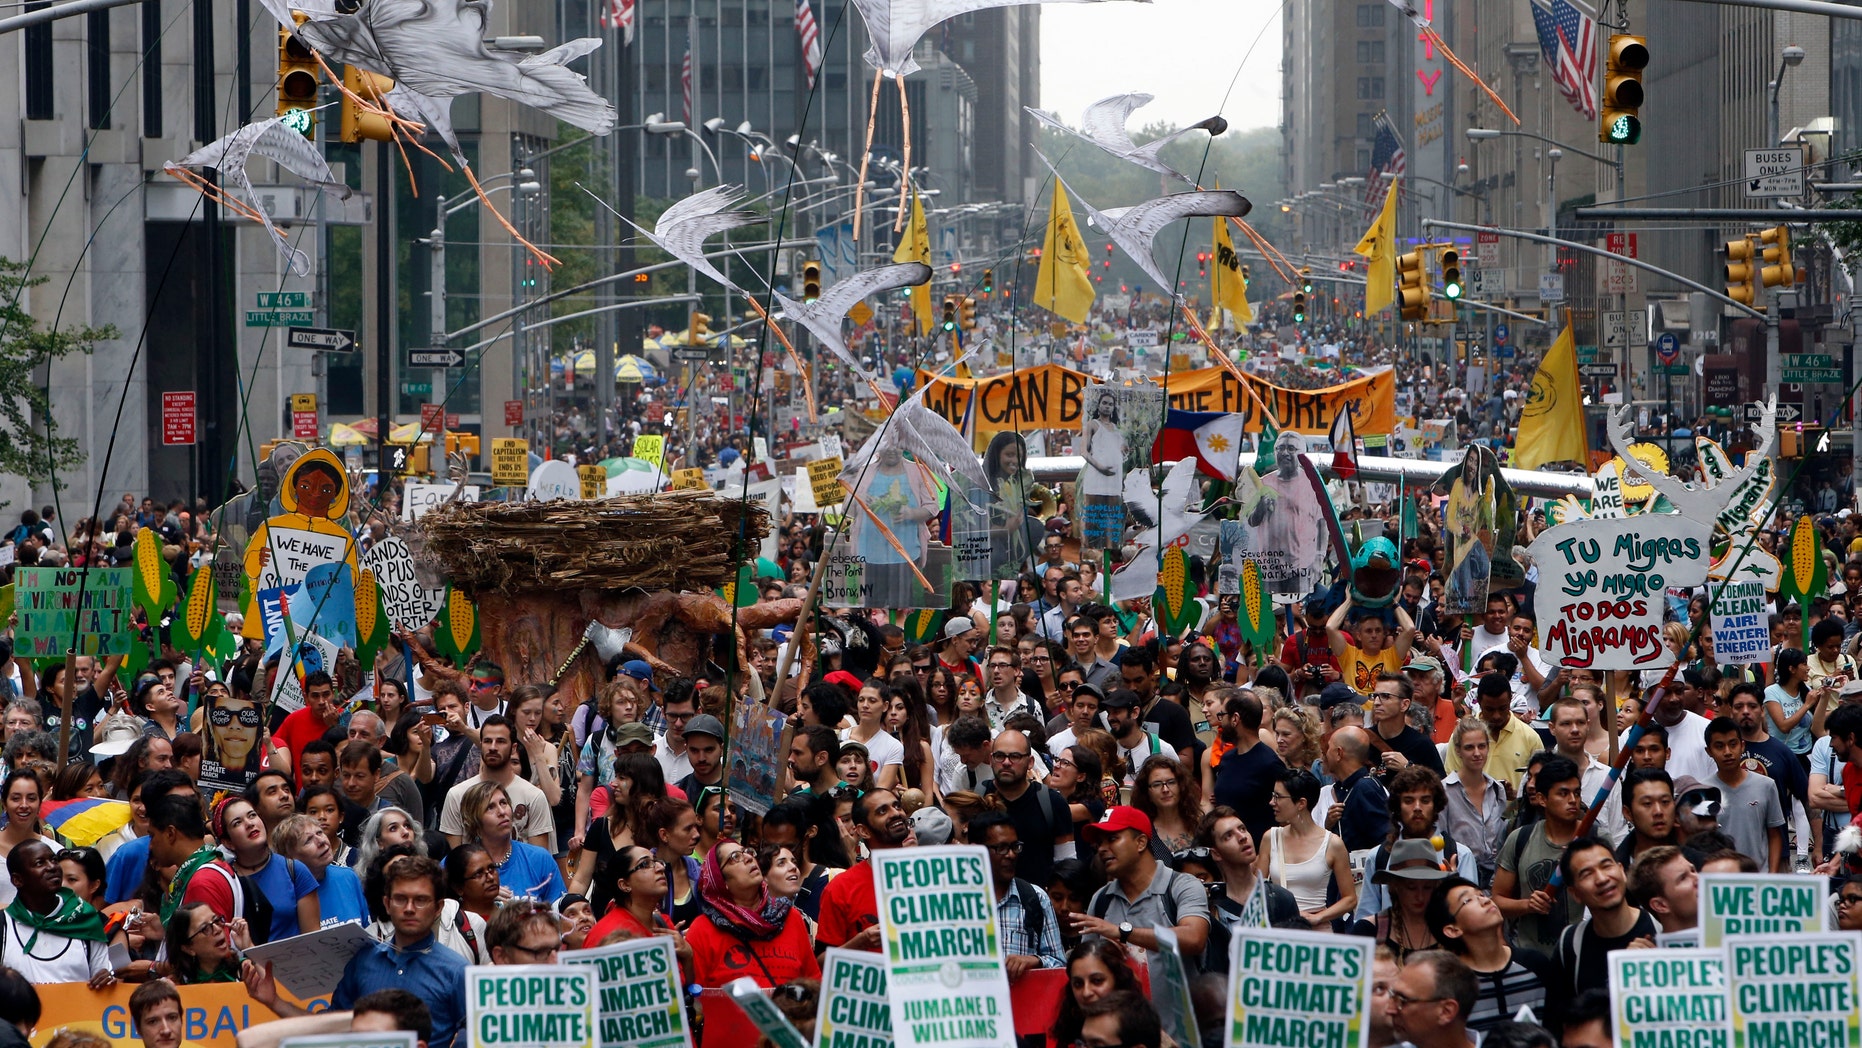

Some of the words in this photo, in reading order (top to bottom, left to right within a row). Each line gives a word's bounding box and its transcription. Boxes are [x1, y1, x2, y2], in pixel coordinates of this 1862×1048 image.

[1756, 153, 1792, 163] BUSES
[1760, 166, 1788, 175] ONLY
[1480, 234, 1496, 242] ZONE
[260, 294, 269, 306] W
[277, 294, 292, 306] 46
[246, 313, 275, 321] LITTLE
[280, 312, 312, 321] BRAZIL
[298, 333, 316, 343] ONE
[325, 336, 345, 345] WAY
[1613, 326, 1636, 334] ONY
[1693, 331, 1717, 340] 1212
[1791, 356, 1800, 365] W
[1805, 356, 1820, 365] 46
[1782, 370, 1808, 378] LITTLE
[1812, 370, 1840, 378] BRAZIL
[924, 376, 965, 425] WE
[981, 370, 1050, 424] CAN
[1221, 370, 1328, 430] FUTURE
[635, 438, 660, 454] SOLAR
[514, 463, 521, 471] US
[814, 463, 835, 472] HUMAN
[1699, 444, 1723, 480] Tod
[811, 472, 828, 481] NEEDS
[1595, 477, 1618, 491] WE
[410, 485, 473, 506] Earh
[1592, 494, 1622, 510] ARE
[1716, 458, 1770, 532] Migrantes
[277, 535, 301, 552] WE
[301, 542, 334, 560] HAVE
[364, 540, 408, 567] HANDS
[1240, 549, 1284, 558] Severiano
[1555, 537, 1600, 565] TU
[288, 558, 308, 572] THE
[826, 565, 842, 577] The
[844, 564, 863, 577] Point
[19, 570, 38, 587] I'M
[55, 571, 89, 586] NOT
[97, 571, 120, 586] AN
[15, 585, 132, 610] ENVIRONMNTALIST
[382, 583, 410, 605] NDS
[1727, 583, 1764, 598] DEMAND
[386, 600, 436, 616] OTHER
[1560, 600, 1647, 623] TODOS
[1712, 598, 1766, 616] CLEAN:
[24, 612, 46, 632] I'M
[54, 611, 75, 631] AN
[82, 610, 131, 634] EARTH
[263, 599, 284, 637] ON'T
[1723, 615, 1758, 628] AIR!
[1715, 628, 1768, 641] WATER!
[320, 648, 328, 660] THE
[556, 636, 590, 678] COLUMBUS
[1716, 640, 1768, 653] ENERGY!
[286, 681, 299, 692] FIGHT
[201, 764, 226, 774] CLIMATE
[884, 857, 984, 889] PEOPLE'S
[890, 893, 987, 925] CLIMATE
[1712, 886, 1754, 916] WE
[1760, 887, 1814, 917] CAN
[900, 928, 986, 960] MARCH
[569, 948, 667, 983] OPLE'S
[1243, 940, 1360, 978] PEOPLE'S
[1736, 944, 1850, 976] PEOPLE'S
[479, 976, 586, 1007] PEOPLE'S
[600, 979, 669, 1013] IMATE
[1242, 977, 1353, 1014] CLIMATE
[1739, 982, 1849, 1014] CLIMATE
[831, 995, 892, 1032] CLIM
[904, 996, 983, 1021] JUMAANE
[987, 996, 1001, 1016] D.
[102, 1004, 249, 1040] GLBAL
[481, 1012, 583, 1043] CLIMATE
[912, 1019, 997, 1044] WILLIAMS
[1246, 1014, 1344, 1048] MARCH
[832, 1031, 895, 1048] MAR
[1634, 1028, 1726, 1048] MARCH
[1748, 1020, 1845, 1048] MARCH
